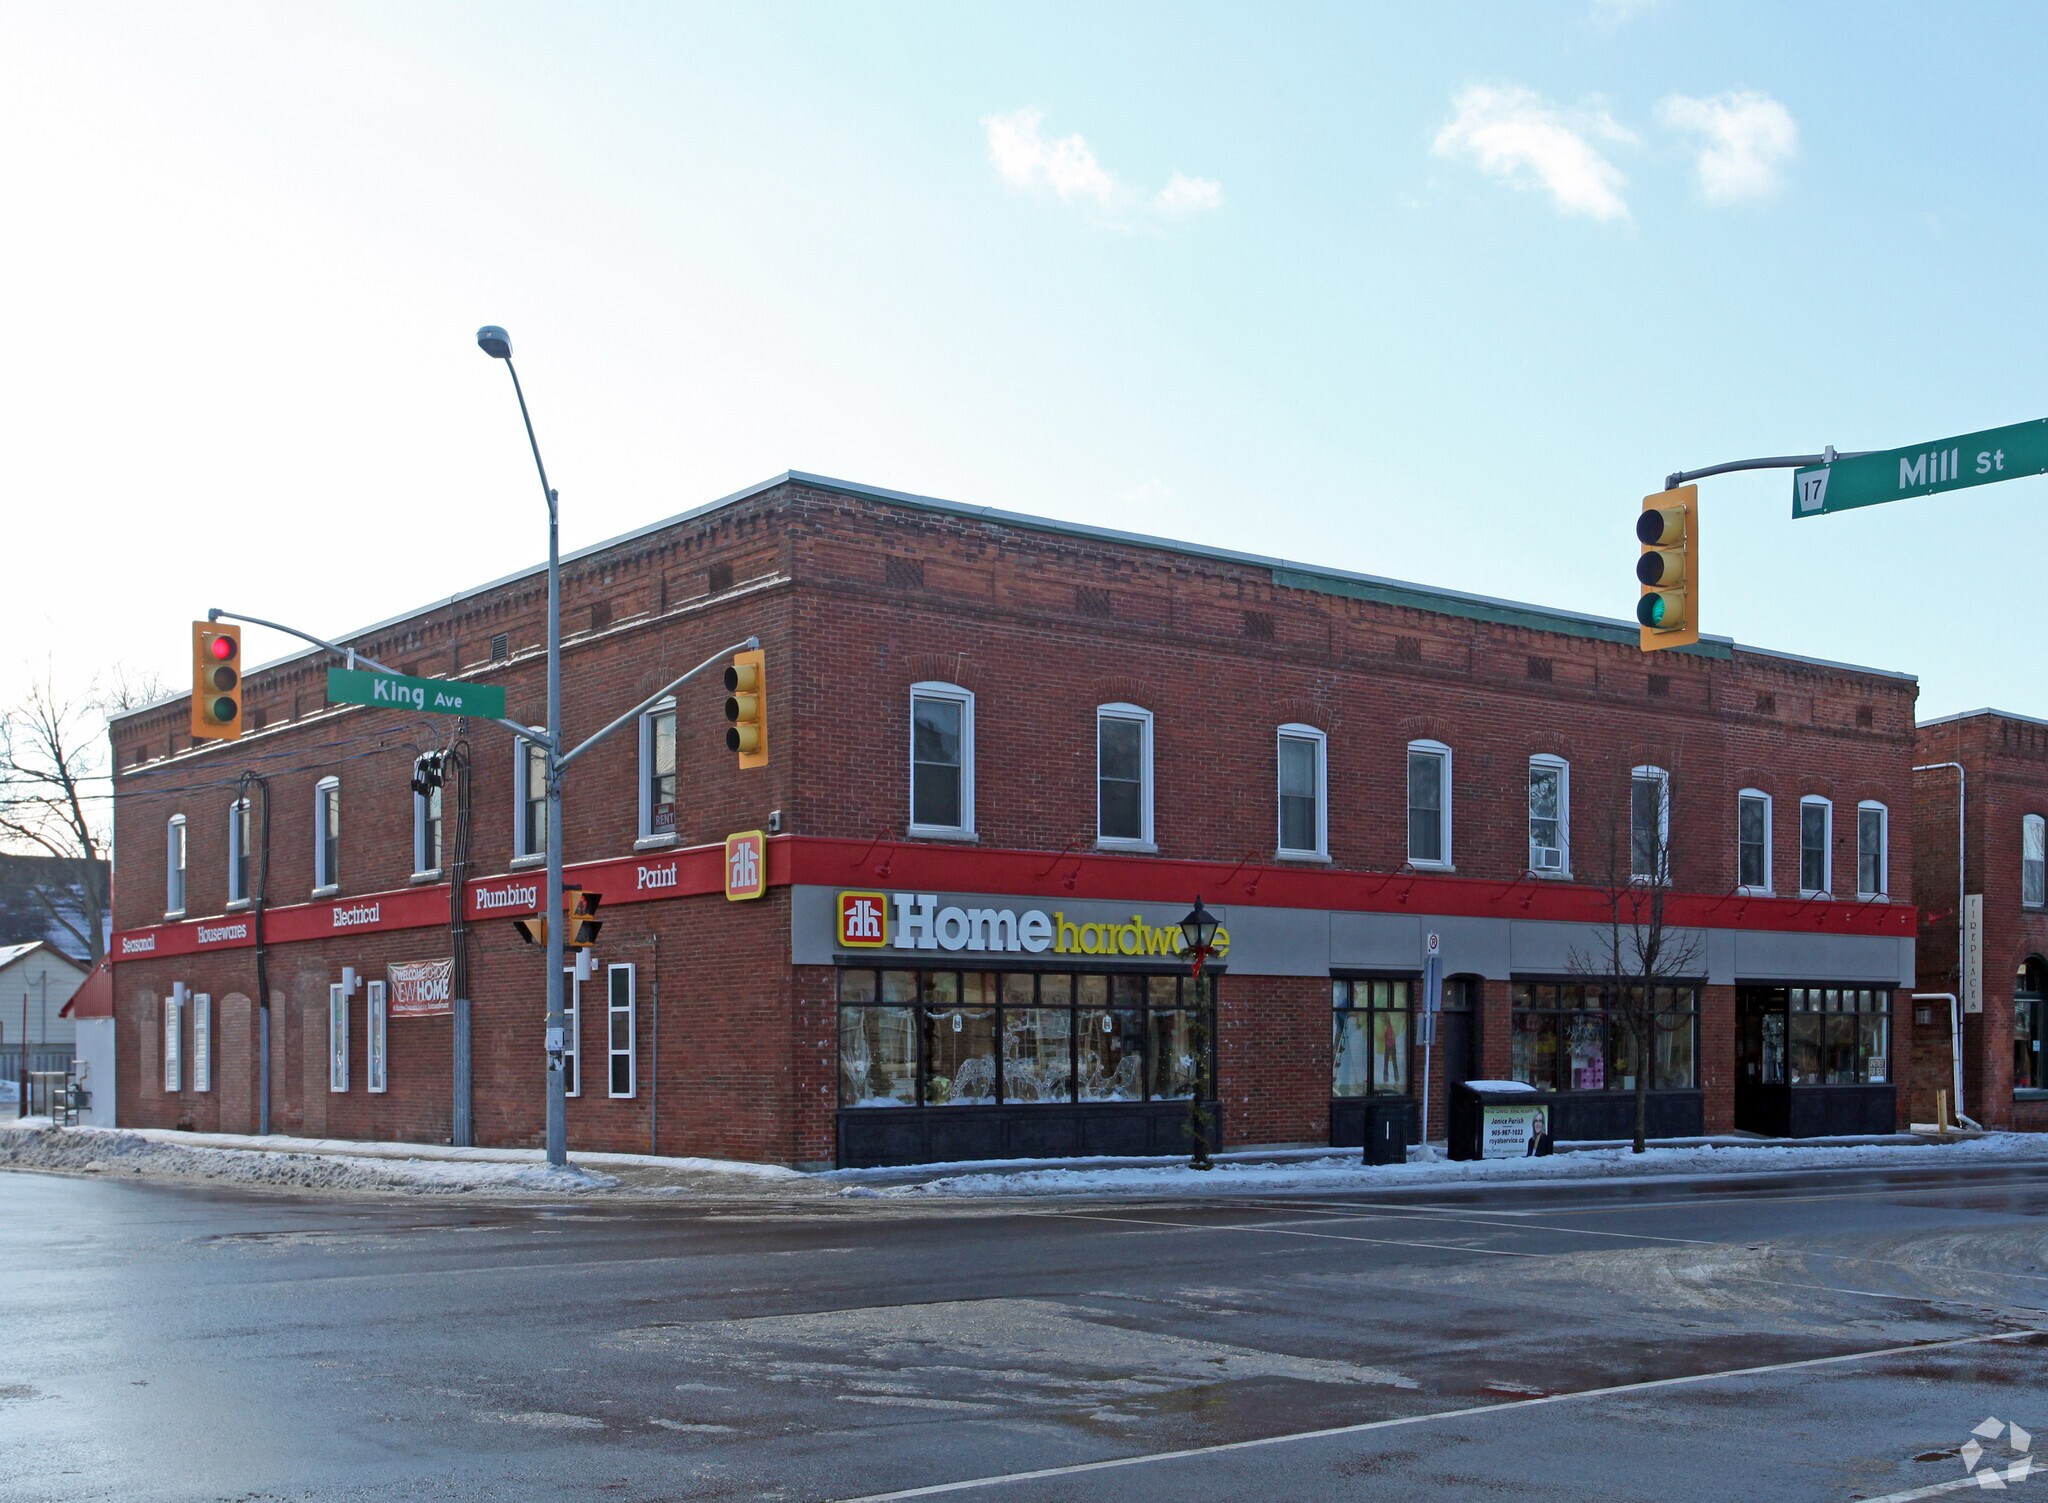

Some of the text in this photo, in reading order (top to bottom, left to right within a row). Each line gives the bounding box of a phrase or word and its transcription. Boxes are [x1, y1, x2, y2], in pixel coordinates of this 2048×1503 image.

[1899, 447, 2005, 490] Mill St
[1804, 479, 1822, 502] 17
[373, 678, 463, 710] King Ave
[655, 812, 674, 826] RENT
[637, 862, 677, 890] Paint
[476, 883, 537, 909] Plumbing
[333, 902, 380, 927] Electrical
[893, 893, 1052, 953] Home
[122, 933, 155, 954] Seasonal
[197, 923, 247, 944] Housewares
[1969, 898, 1977, 1010] FIREPLACES
[392, 978, 449, 1003] NEW HOME
[1508, 1117, 1524, 1125] Parish
[1489, 1137, 1524, 1145] royalservice.ca
